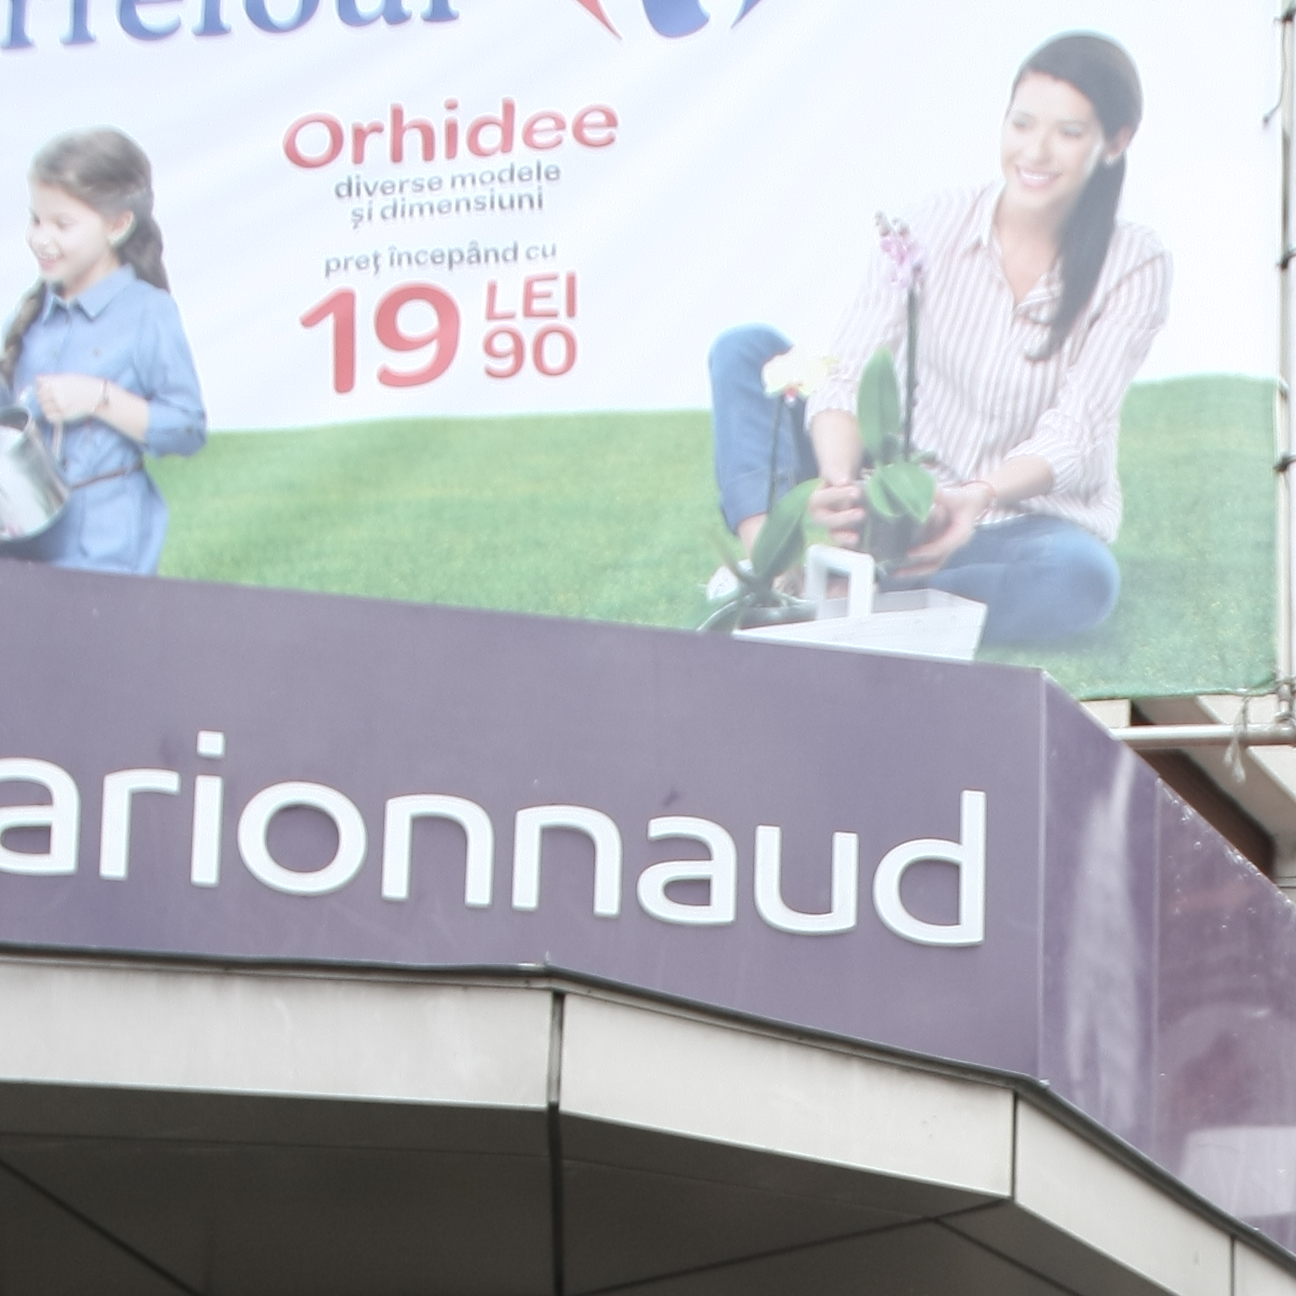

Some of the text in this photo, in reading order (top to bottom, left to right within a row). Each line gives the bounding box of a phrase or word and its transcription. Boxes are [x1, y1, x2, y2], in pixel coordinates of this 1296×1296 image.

[282, 97, 619, 170] Orhidee
[334, 160, 561, 200] diverse modele
[381, 185, 544, 220] dimensiuni
[526, 242, 557, 262] cu
[485, 270, 578, 321] LEI
[300, 279, 461, 395] 19
[482, 324, 579, 379] 90
[0, 730, 985, 948] arionnaud
